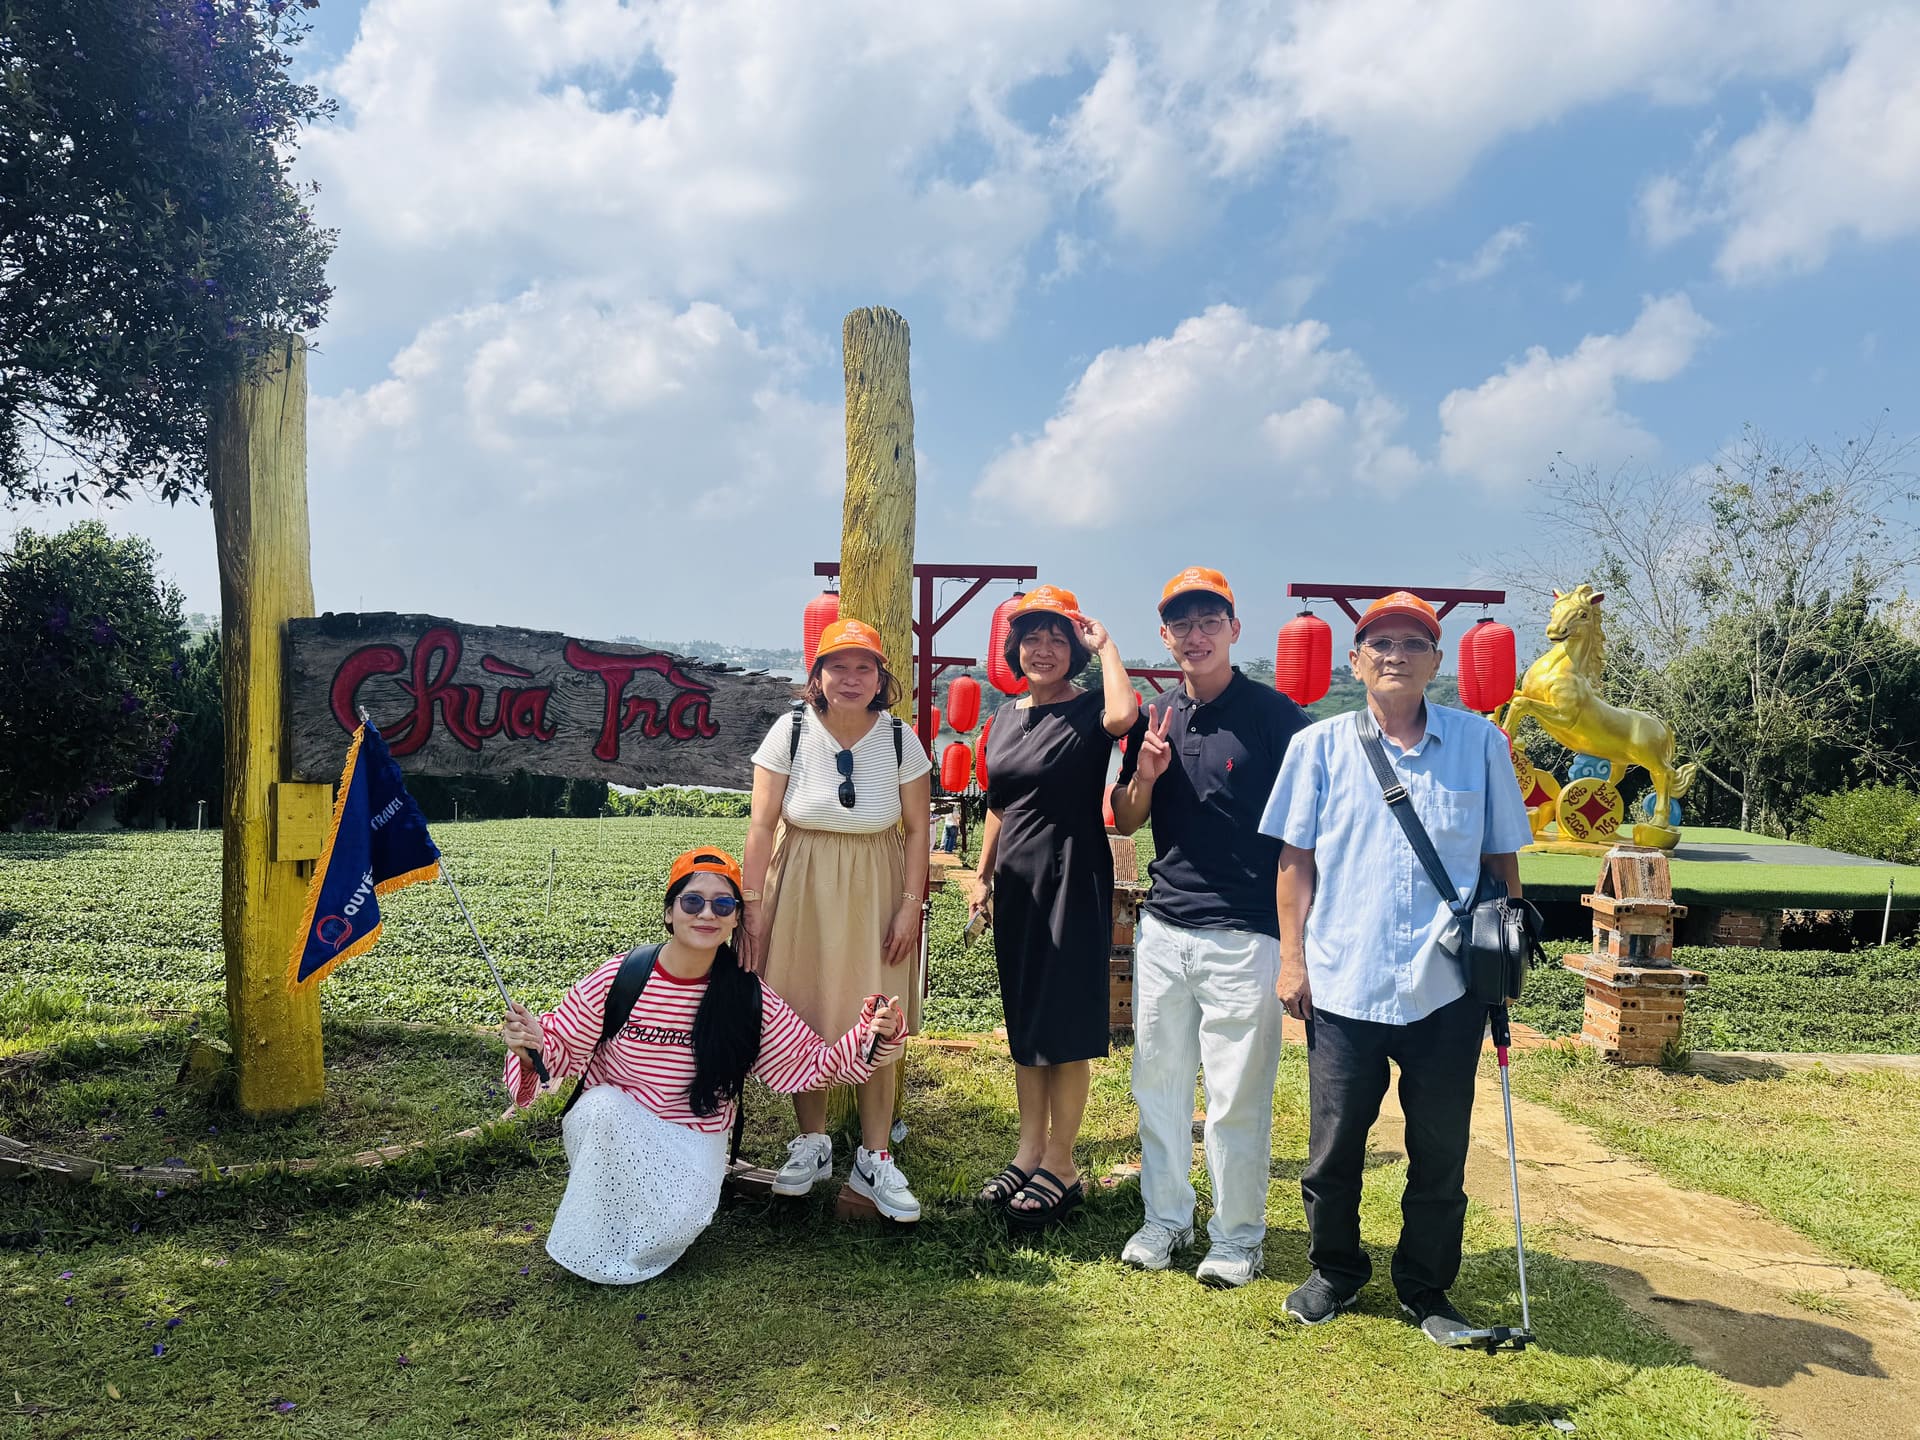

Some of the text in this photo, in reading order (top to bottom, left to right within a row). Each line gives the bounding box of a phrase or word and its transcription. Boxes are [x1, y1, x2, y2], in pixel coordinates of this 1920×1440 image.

[329, 626, 720, 762] Chùa Trà
[1564, 812, 1590, 840] 2026
